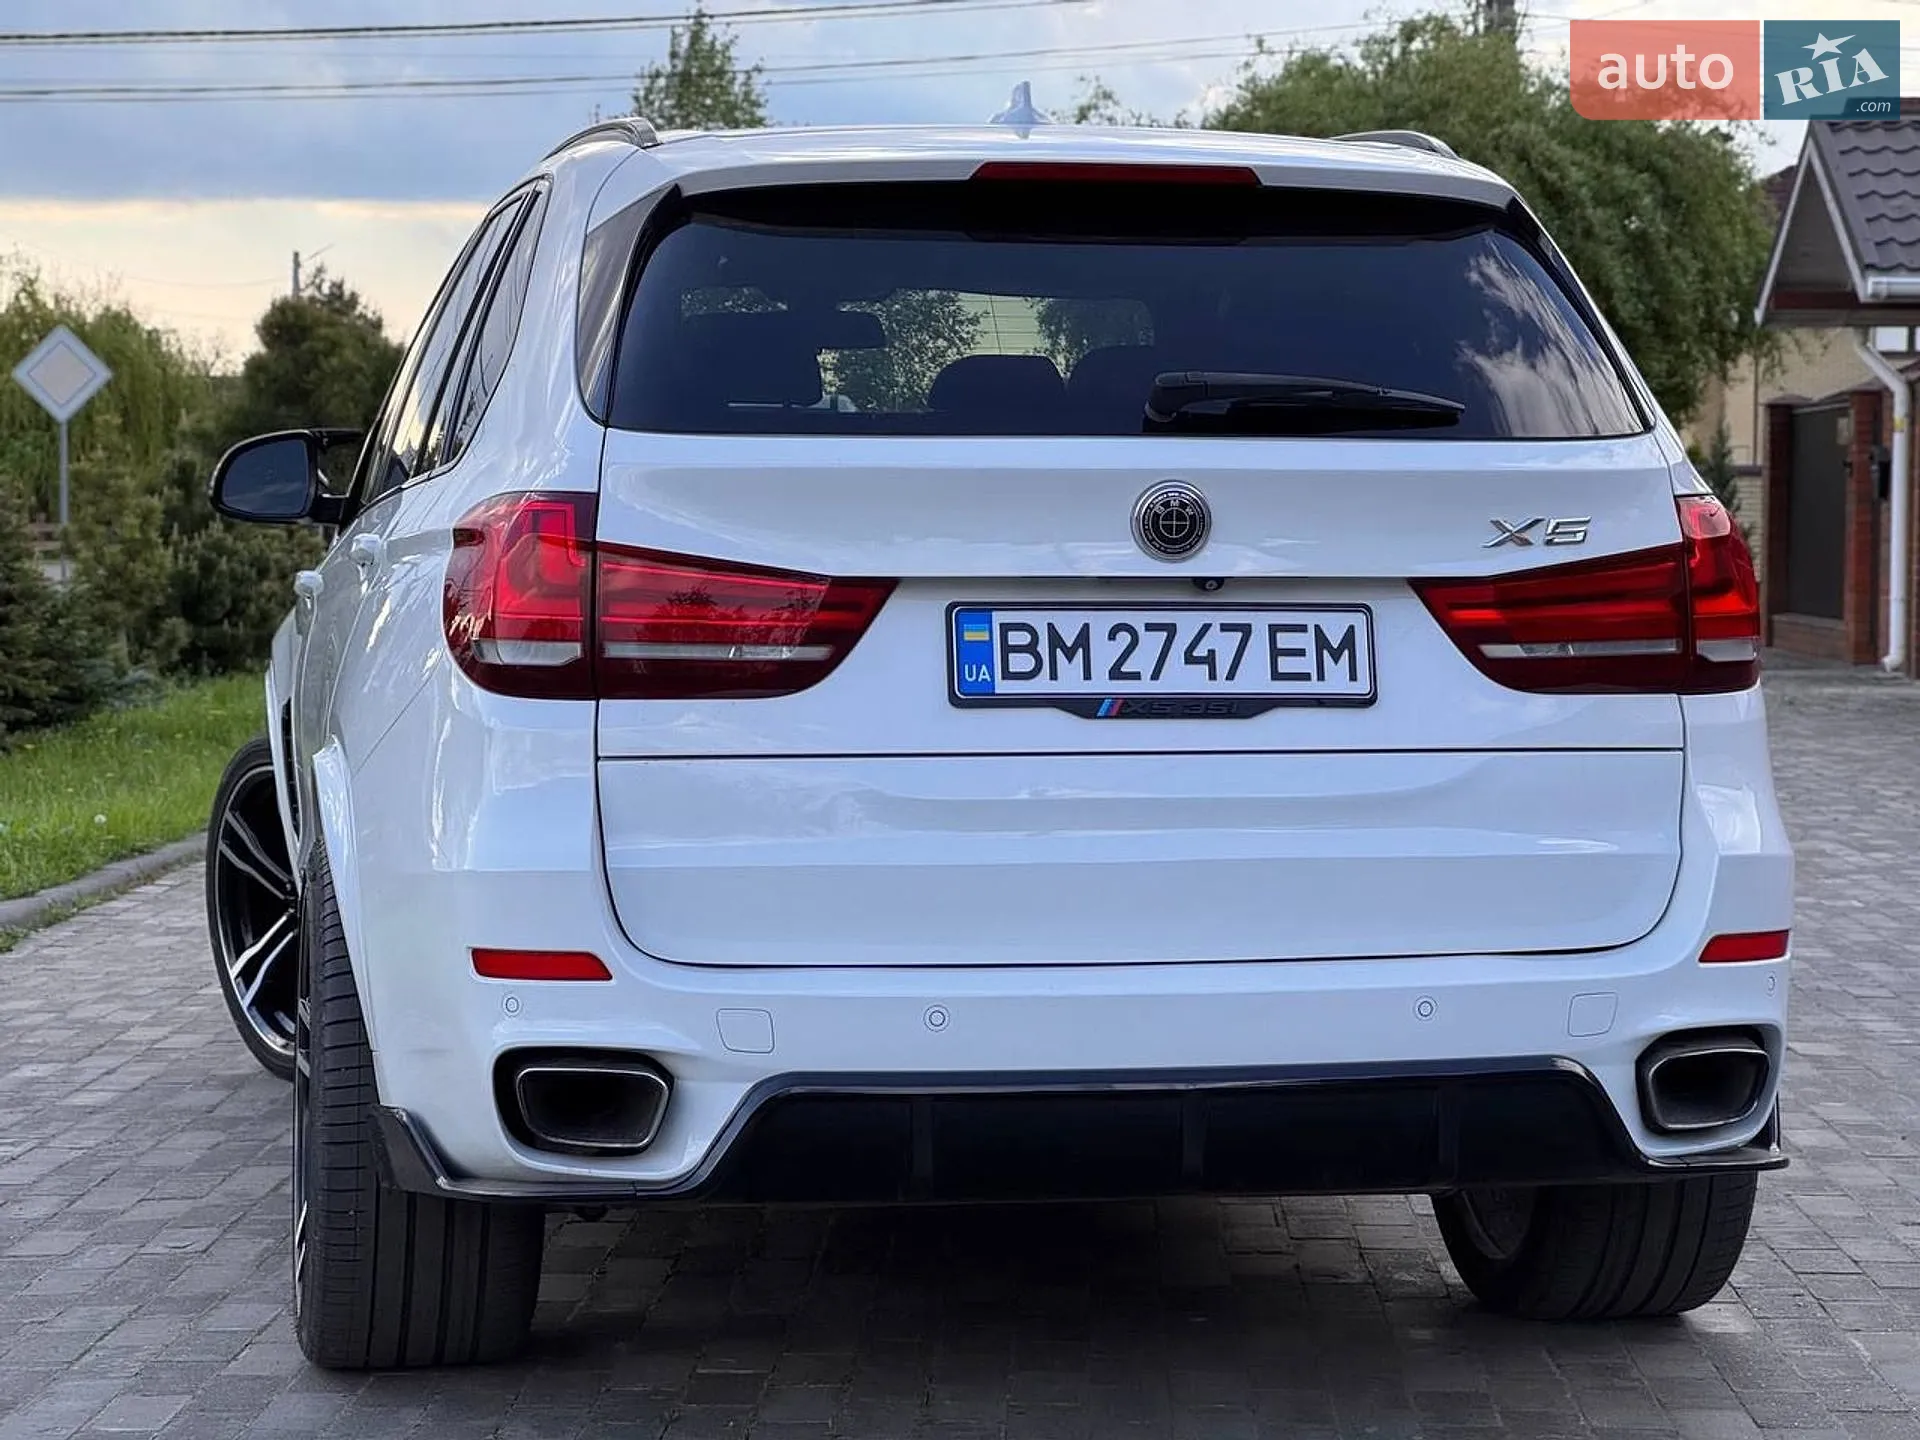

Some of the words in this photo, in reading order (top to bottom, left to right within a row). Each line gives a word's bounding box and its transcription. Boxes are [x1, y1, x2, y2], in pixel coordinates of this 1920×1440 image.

[1481, 515, 1592, 548] X5
[999, 622, 1092, 681] BM
[1107, 622, 1252, 682] 2747
[1267, 623, 1358, 682] EM
[964, 664, 991, 682] UA
